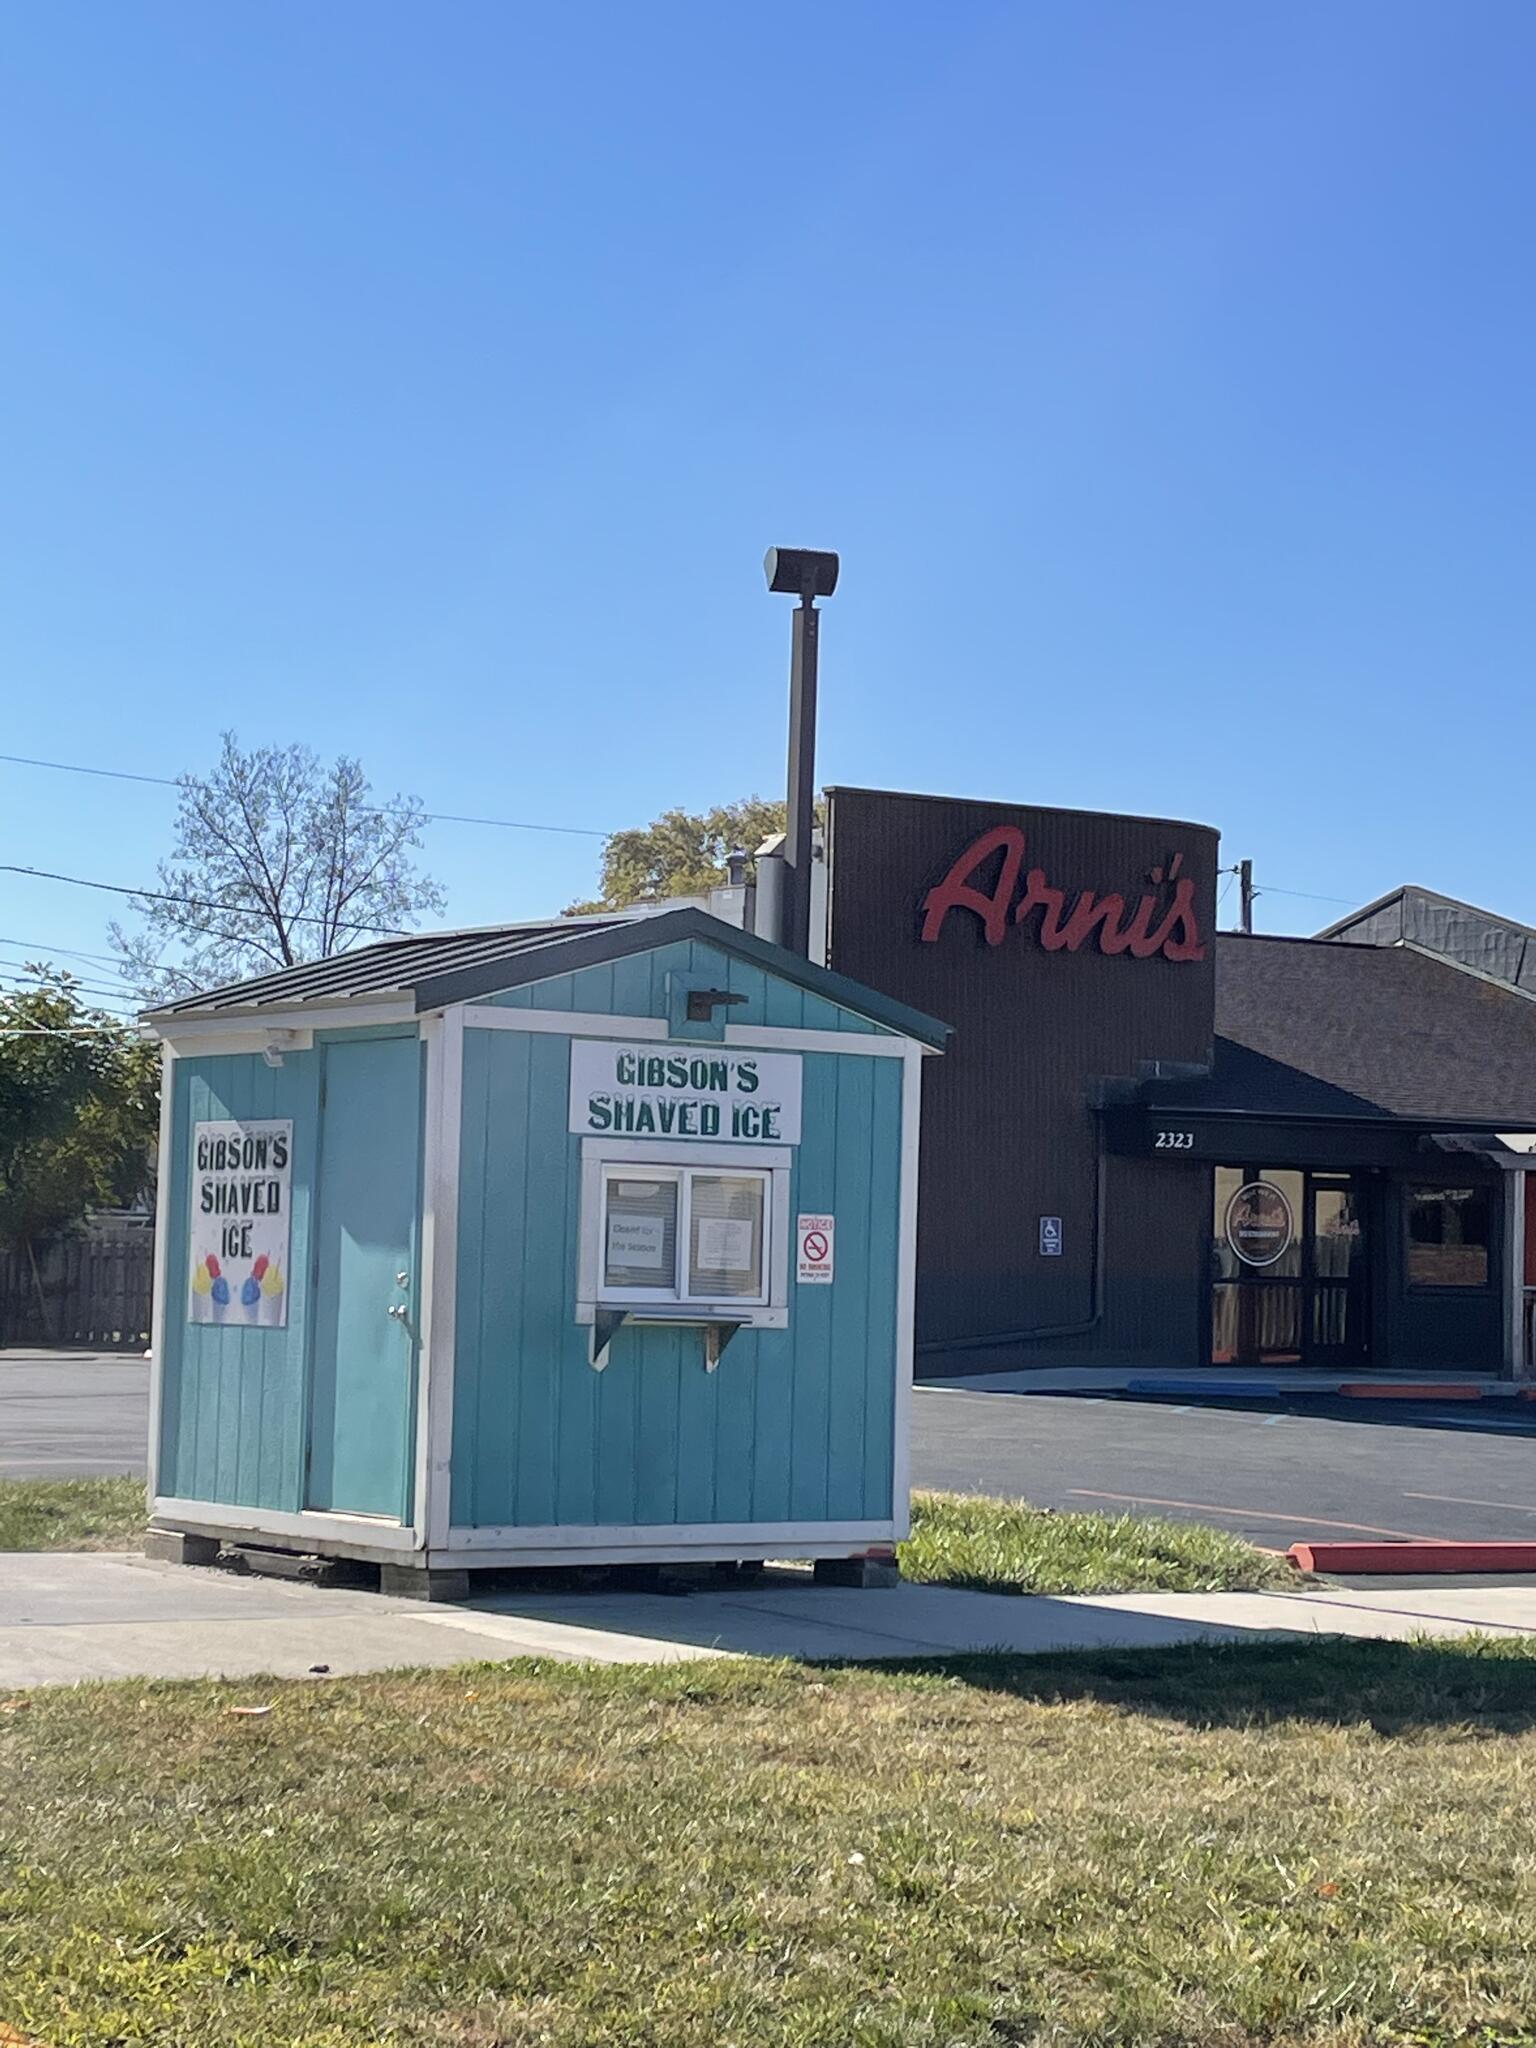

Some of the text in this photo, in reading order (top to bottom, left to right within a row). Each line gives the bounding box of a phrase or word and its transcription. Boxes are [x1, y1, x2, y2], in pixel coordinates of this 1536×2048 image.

[921, 825, 1204, 961] Arni's
[616, 1050, 760, 1093] GIBSON'S
[588, 1091, 782, 1140] SHAVED ICE
[197, 1130, 289, 1171] GIBSON'S
[1155, 1132, 1194, 1149] 2323
[200, 1176, 281, 1214] SHAVED
[221, 1219, 254, 1258] ICE
